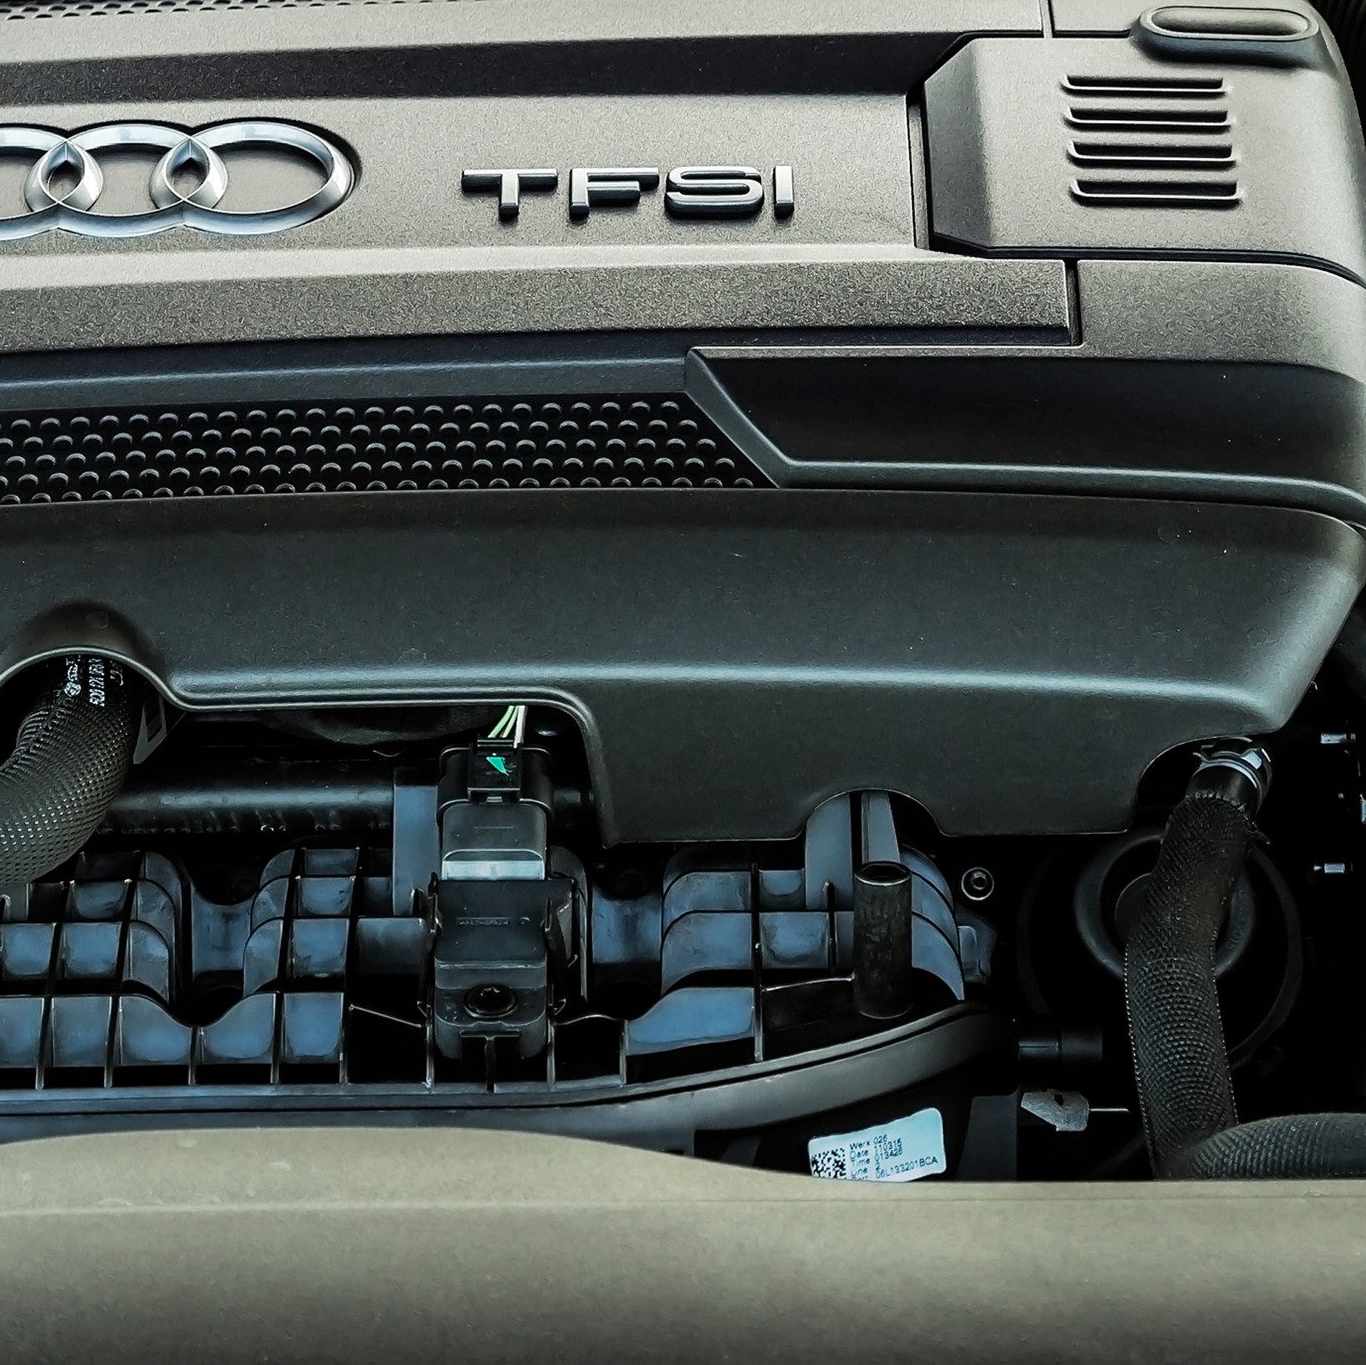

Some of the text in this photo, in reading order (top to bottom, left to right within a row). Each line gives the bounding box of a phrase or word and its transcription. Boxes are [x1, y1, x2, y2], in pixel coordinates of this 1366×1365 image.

[461, 166, 794, 221] TFSI
[849, 1140, 871, 1150] Werk
[850, 1138, 903, 1160] Date 110315
